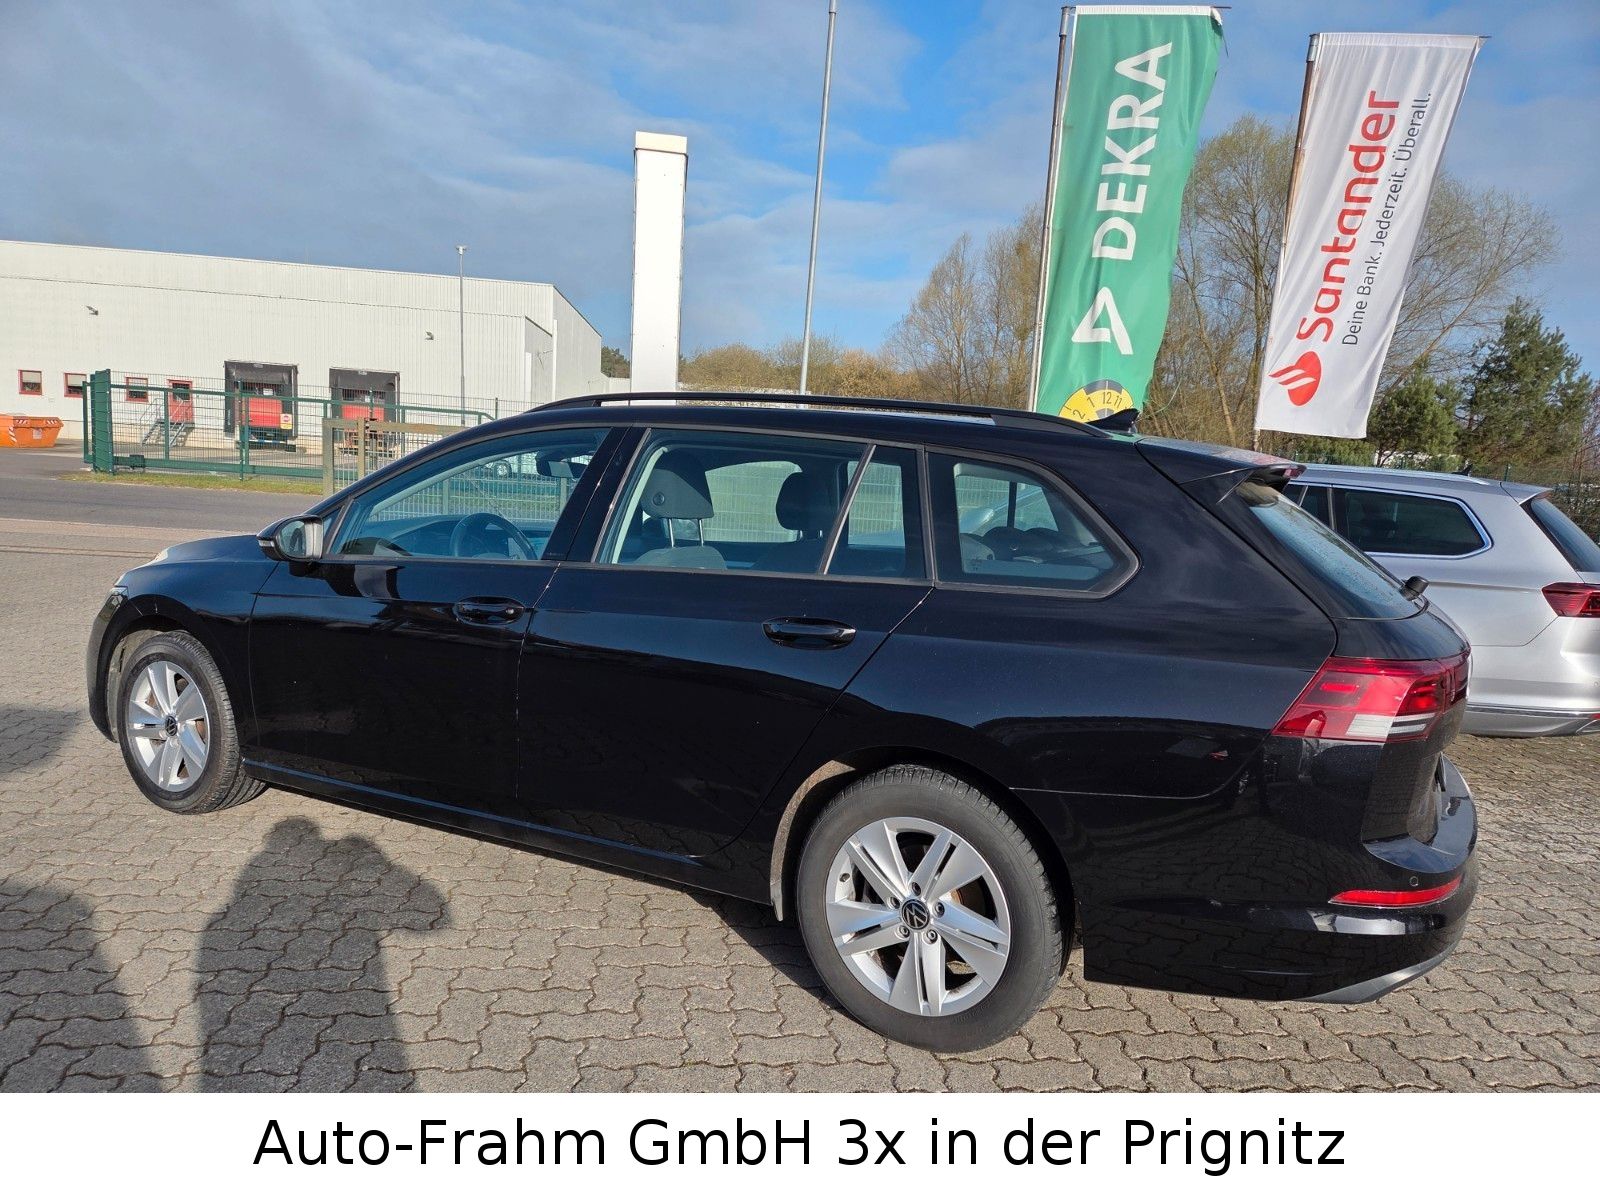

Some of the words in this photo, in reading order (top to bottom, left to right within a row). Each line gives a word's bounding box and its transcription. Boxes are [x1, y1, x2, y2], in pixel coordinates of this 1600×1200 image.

[1092, 42, 1173, 261] DEKRA
[1295, 91, 1400, 343] Santander
[1342, 300, 1368, 345] Deine
[1357, 251, 1383, 296] Bank.
[1370, 167, 1408, 248] Jederzeit.
[1392, 93, 1432, 161] Überall.
[1102, 391, 1112, 405] 12
